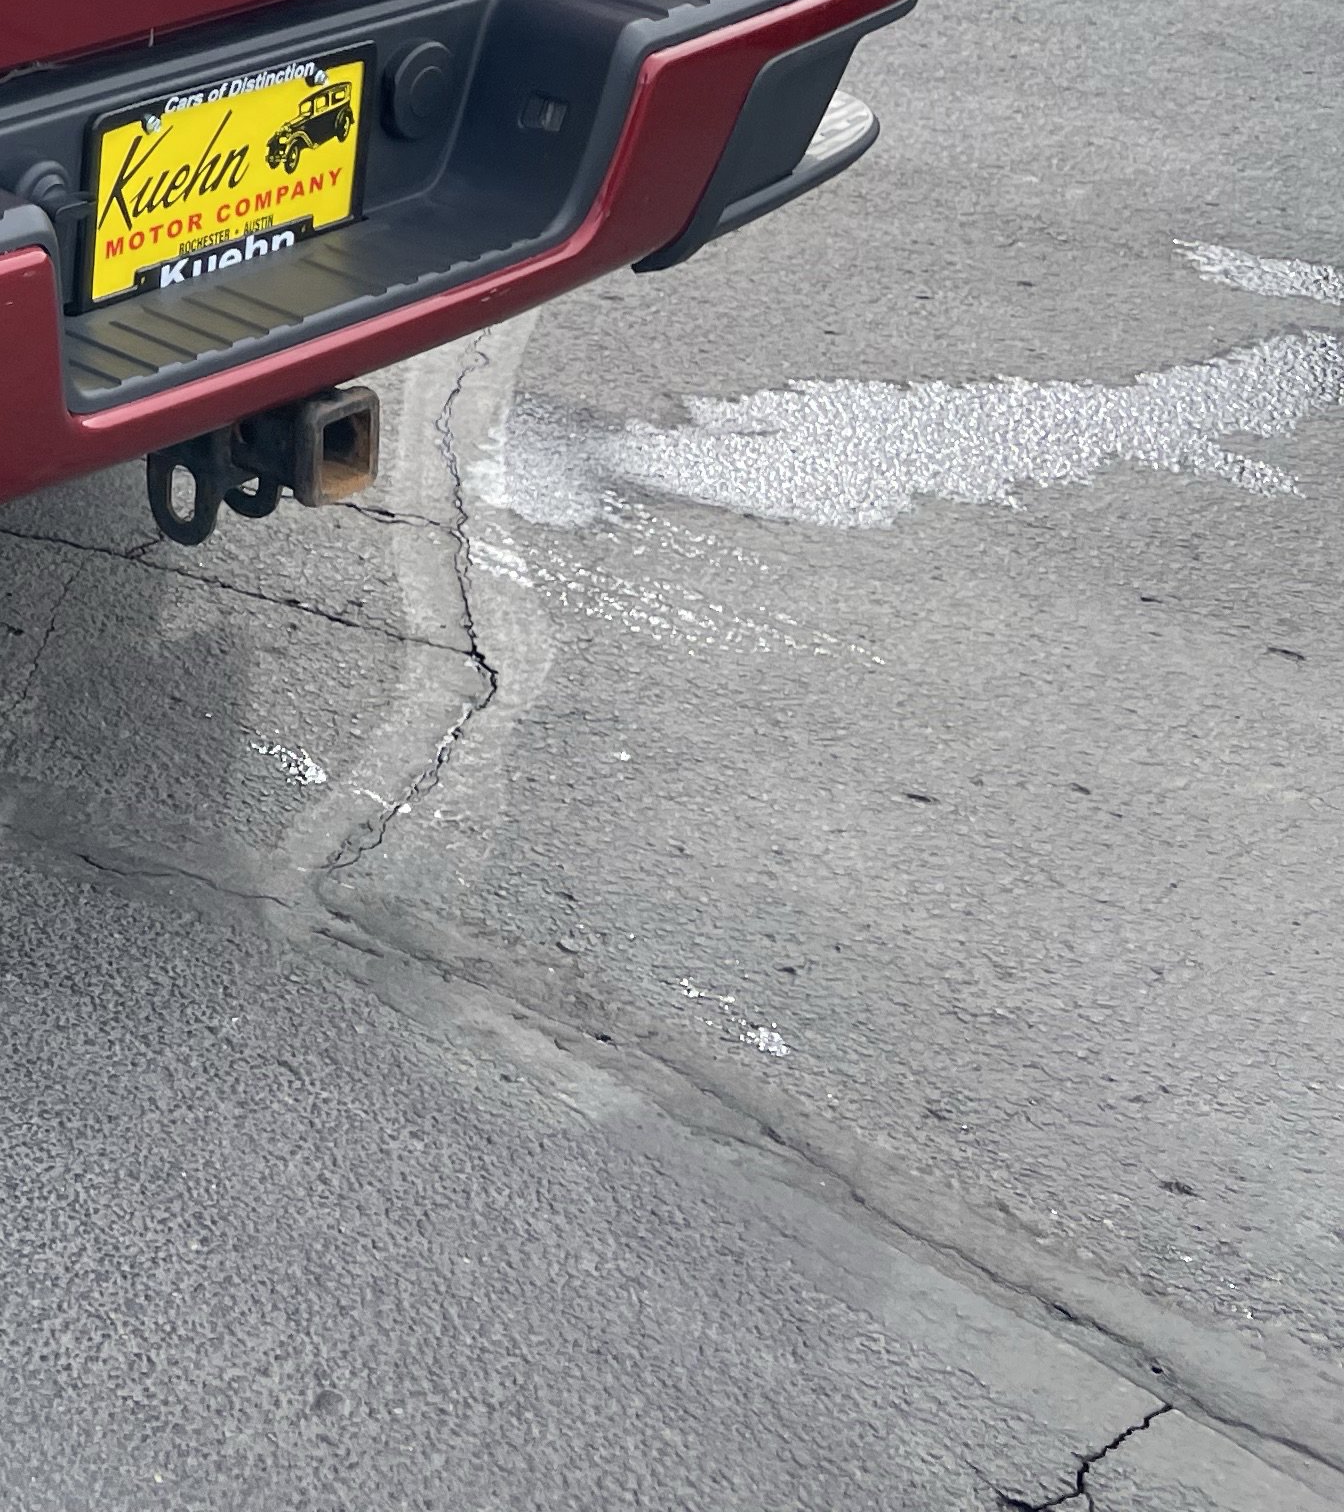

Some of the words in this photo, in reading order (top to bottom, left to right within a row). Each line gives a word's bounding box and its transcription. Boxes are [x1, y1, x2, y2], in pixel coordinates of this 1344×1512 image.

[164, 92, 204, 114] Cars
[207, 82, 228, 102] of
[228, 61, 315, 97] Distinction
[98, 109, 250, 232] Kuehn
[105, 212, 203, 260] MOTOR
[216, 167, 343, 223] COMPANY
[178, 228, 230, 255] ROCHESTER
[243, 214, 274, 234] AUSTIN
[160, 230, 295, 288] Kuehn
